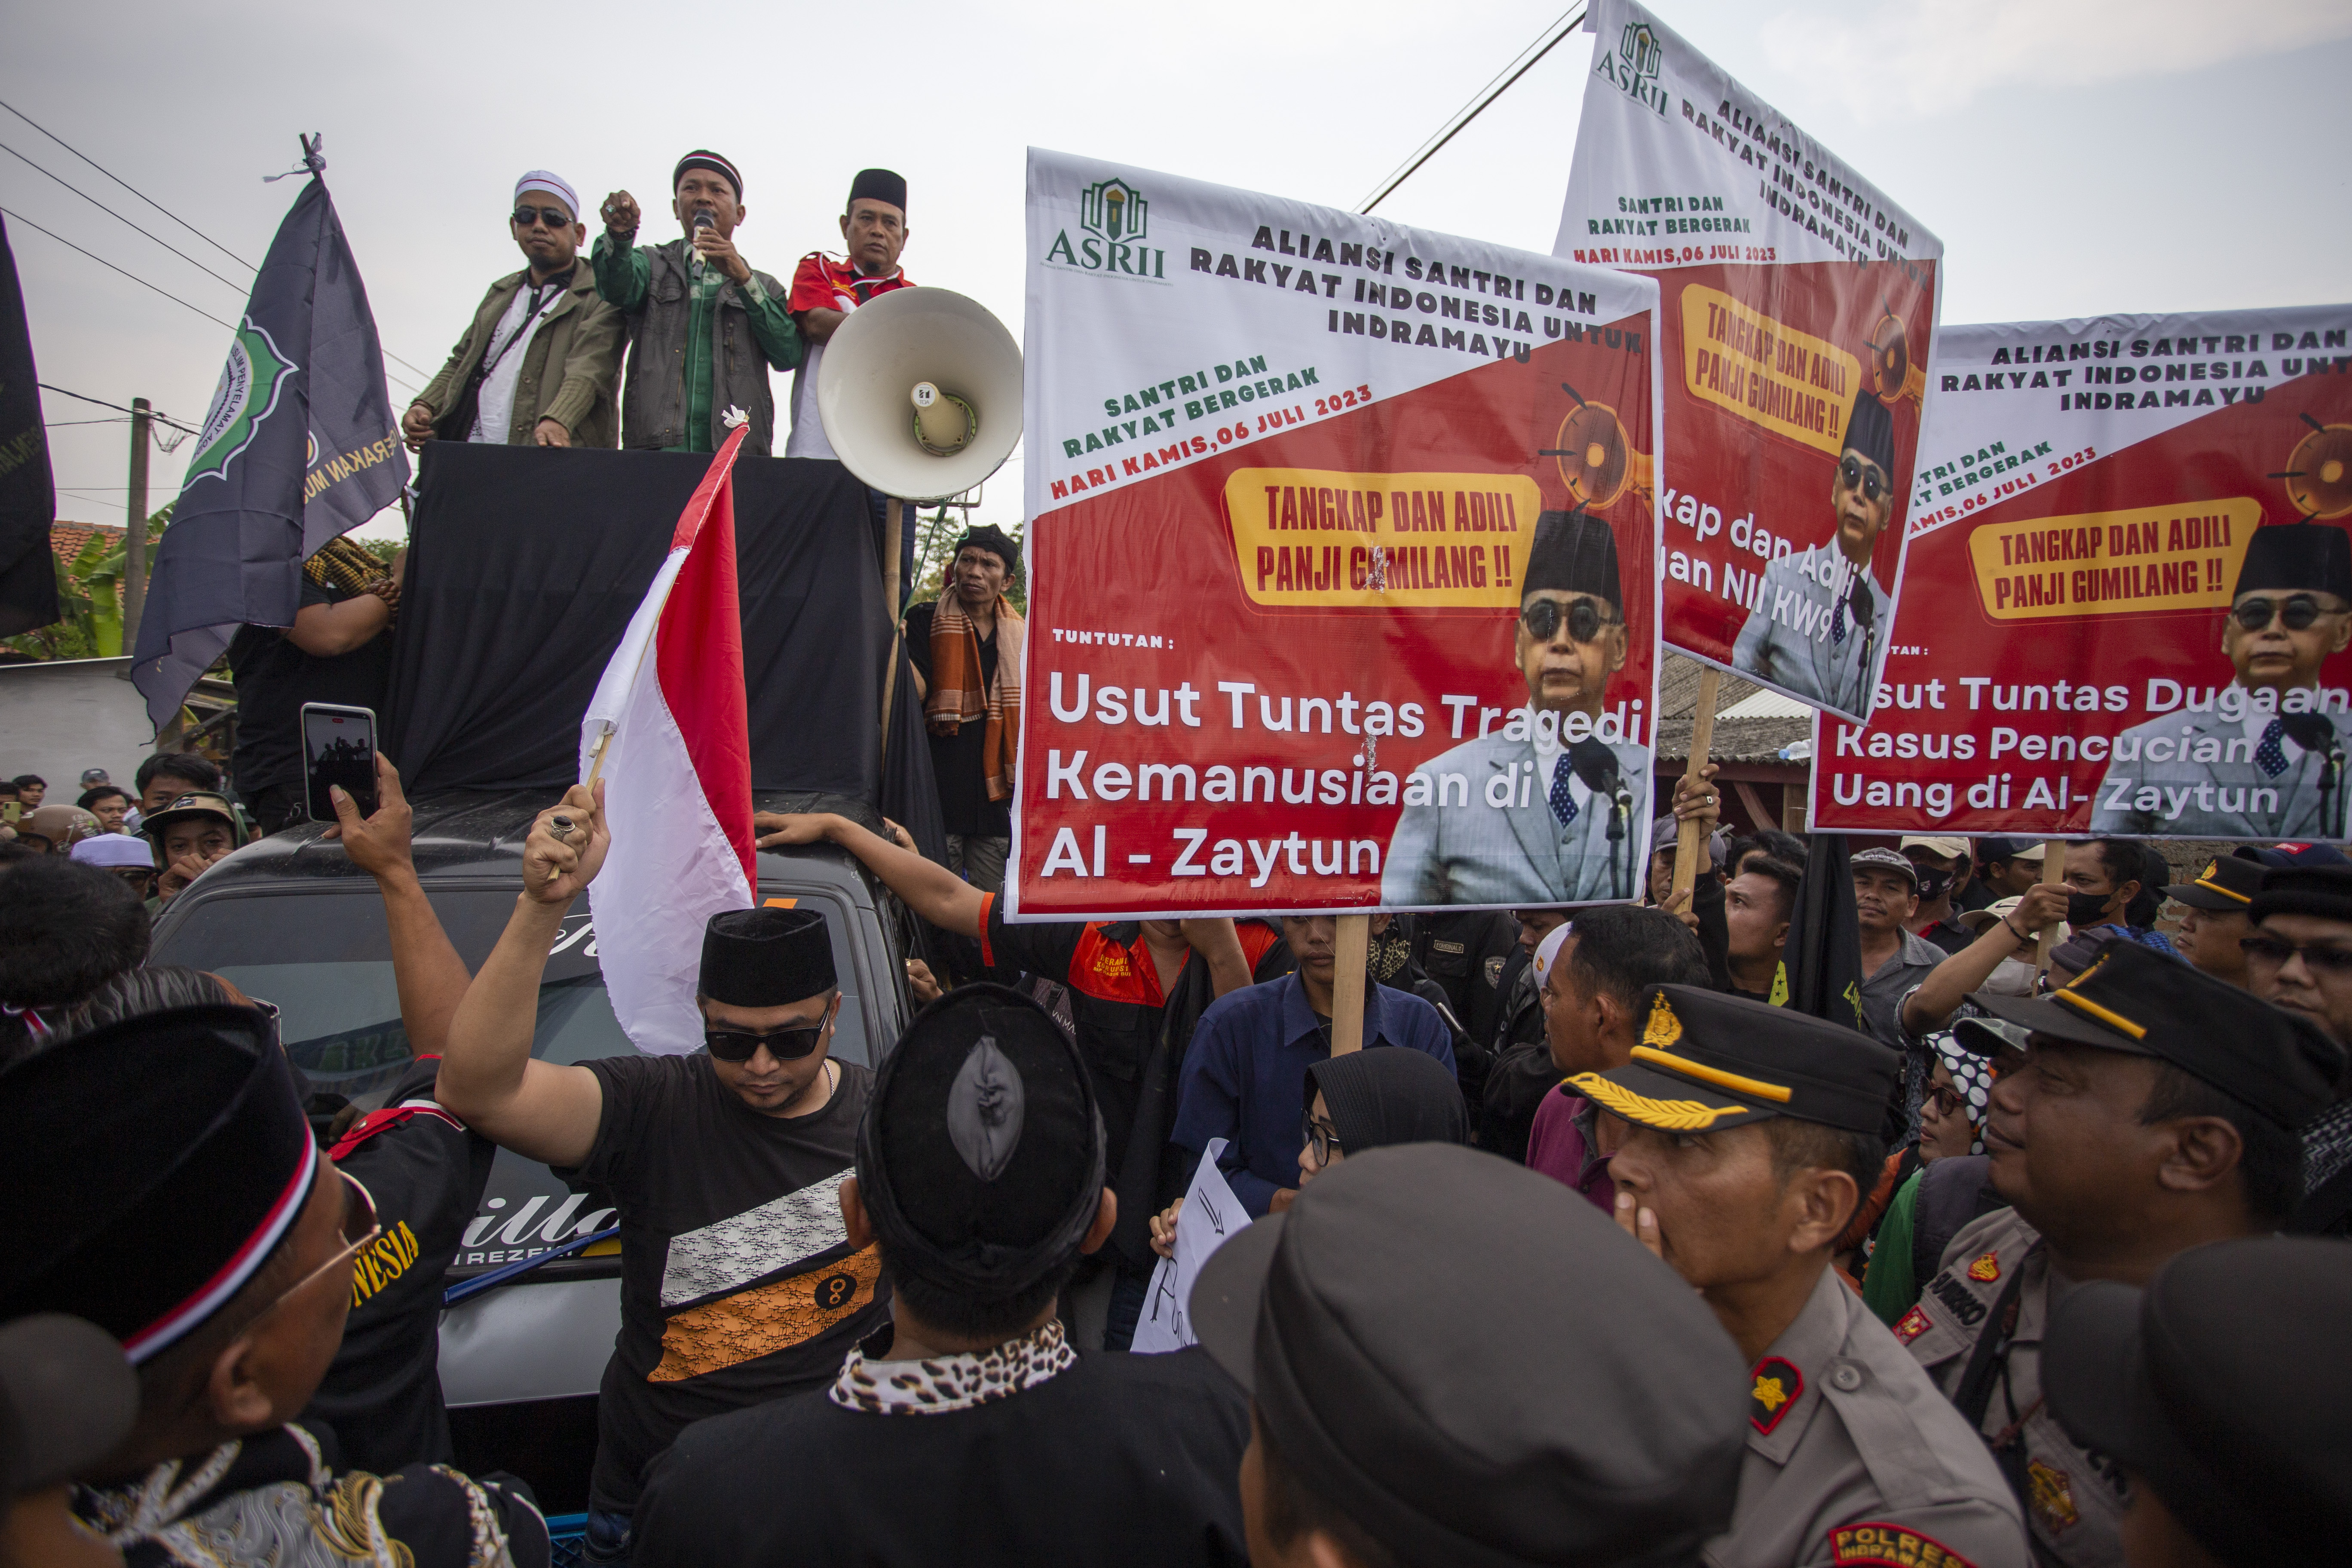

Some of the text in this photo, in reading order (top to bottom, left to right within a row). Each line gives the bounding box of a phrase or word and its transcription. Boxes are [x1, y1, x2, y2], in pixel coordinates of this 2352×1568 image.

[1596, 49, 1668, 117] ASRII
[1682, 99, 1928, 292] RAKYAT INDONESIA UNTUK
[1717, 100, 1908, 250] ALIANSI SANTRI DAN
[1588, 217, 1750, 236] RAKYAT BERGERAK
[1618, 196, 1723, 214] SANTRI DAN
[1760, 179, 1868, 271] INDRAMAYU
[1045, 228, 1166, 279] ASRII
[1251, 225, 1597, 316] ALIANSI SANTRI DAN
[1574, 248, 1618, 264] HARI
[1709, 245, 1739, 260] JULI
[1745, 246, 1776, 261] 2023
[1190, 247, 1643, 355] RAKYAT INDONESIA UNTUK
[1328, 309, 1531, 364] INDRAMAYU
[1708, 302, 1846, 398] TANGKAP DAN ADILI
[1991, 329, 2346, 365] ALIANSI SANTRI DAN
[1104, 354, 1268, 418] SANTRI DAN
[1695, 348, 1744, 397] PANJI
[1748, 373, 1825, 435] GUMILANG
[1941, 355, 2352, 392] RAKYAT INDONESIA UNT
[2060, 386, 2265, 411] INDRAMAYU
[1063, 367, 1320, 459] RAKYAT BERGERAK
[1050, 463, 1116, 501] HARI
[1257, 405, 1305, 438] JULI
[1315, 385, 1372, 417] 2023
[1917, 441, 2006, 488] TRI DAN
[1938, 441, 2053, 497] BERGERAK
[1993, 472, 2037, 500] JULI
[2047, 446, 2097, 477] 2023
[1264, 485, 1518, 533] TANGKAP DAN ADILI
[1730, 512, 1792, 568] dan
[1798, 542, 1856, 600] Adili
[2000, 514, 2232, 567] TANGKAP DAN ADILI
[1256, 546, 1341, 591] PANJI
[1349, 545, 1487, 594] GUMILANG
[1994, 573, 2065, 610] PANJI
[2071, 560, 2199, 603] GUMILANG
[1722, 563, 1767, 614] NII
[1770, 584, 1833, 643] KW9
[1049, 671, 1643, 755] Usut Tuntas Tragedi
[1959, 677, 2129, 712] Tuntas
[2145, 677, 2351, 723] Dugaan
[1837, 725, 2255, 765] Kasus Pencucian
[1046, 749, 1533, 808] Kemanusiaan di
[1832, 774, 1953, 818] Uang
[1967, 772, 2009, 810] di
[2103, 778, 2279, 821] Zaytun
[1040, 826, 1105, 877] Al
[1171, 828, 1380, 888] Zaytun
[1097, 962, 1128, 972] KORUPSI
[1439, 943, 1458, 951] ORIGINAL
[349, 1221, 419, 1308] NESIA
[1836, 1528, 1963, 1568] POLRES
